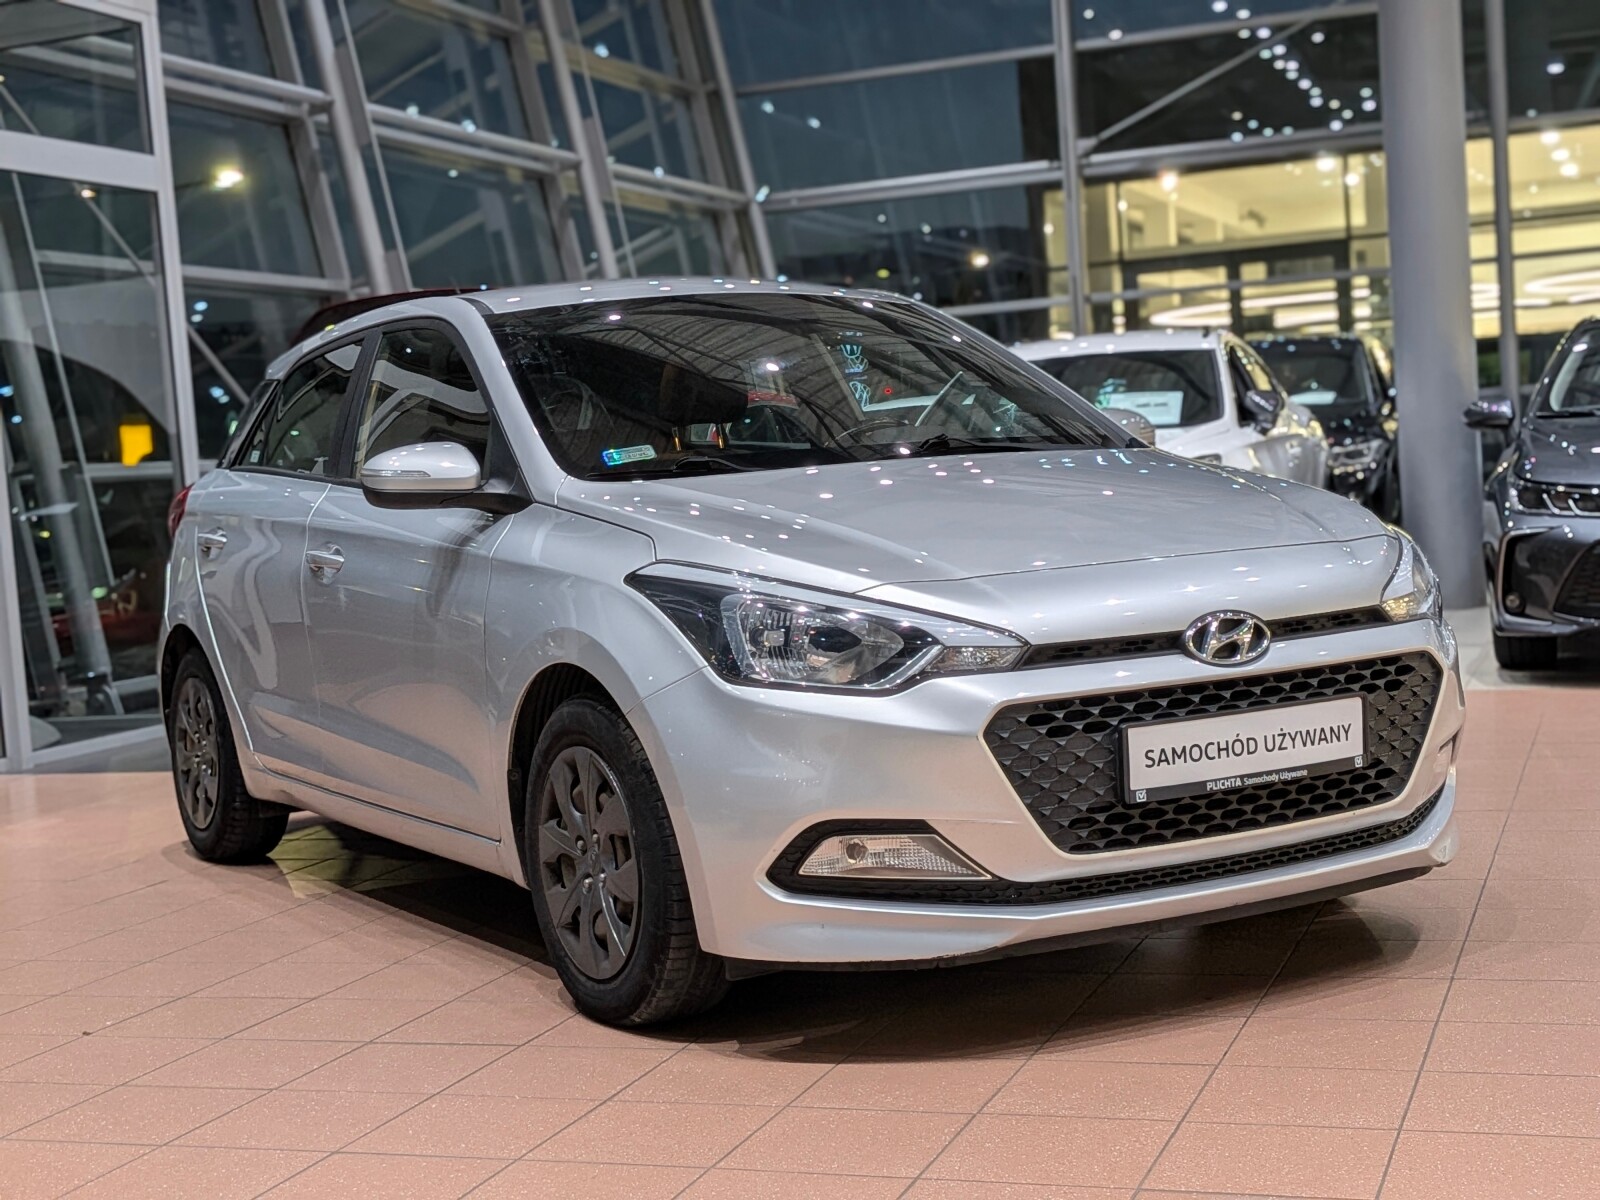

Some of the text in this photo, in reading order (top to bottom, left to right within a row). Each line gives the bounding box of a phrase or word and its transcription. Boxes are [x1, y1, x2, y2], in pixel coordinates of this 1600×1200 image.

[1144, 723, 1352, 769] SAMOCHÓD UŻYWANY
[1206, 769, 1308, 792] PLICHTA Samochody Używane
